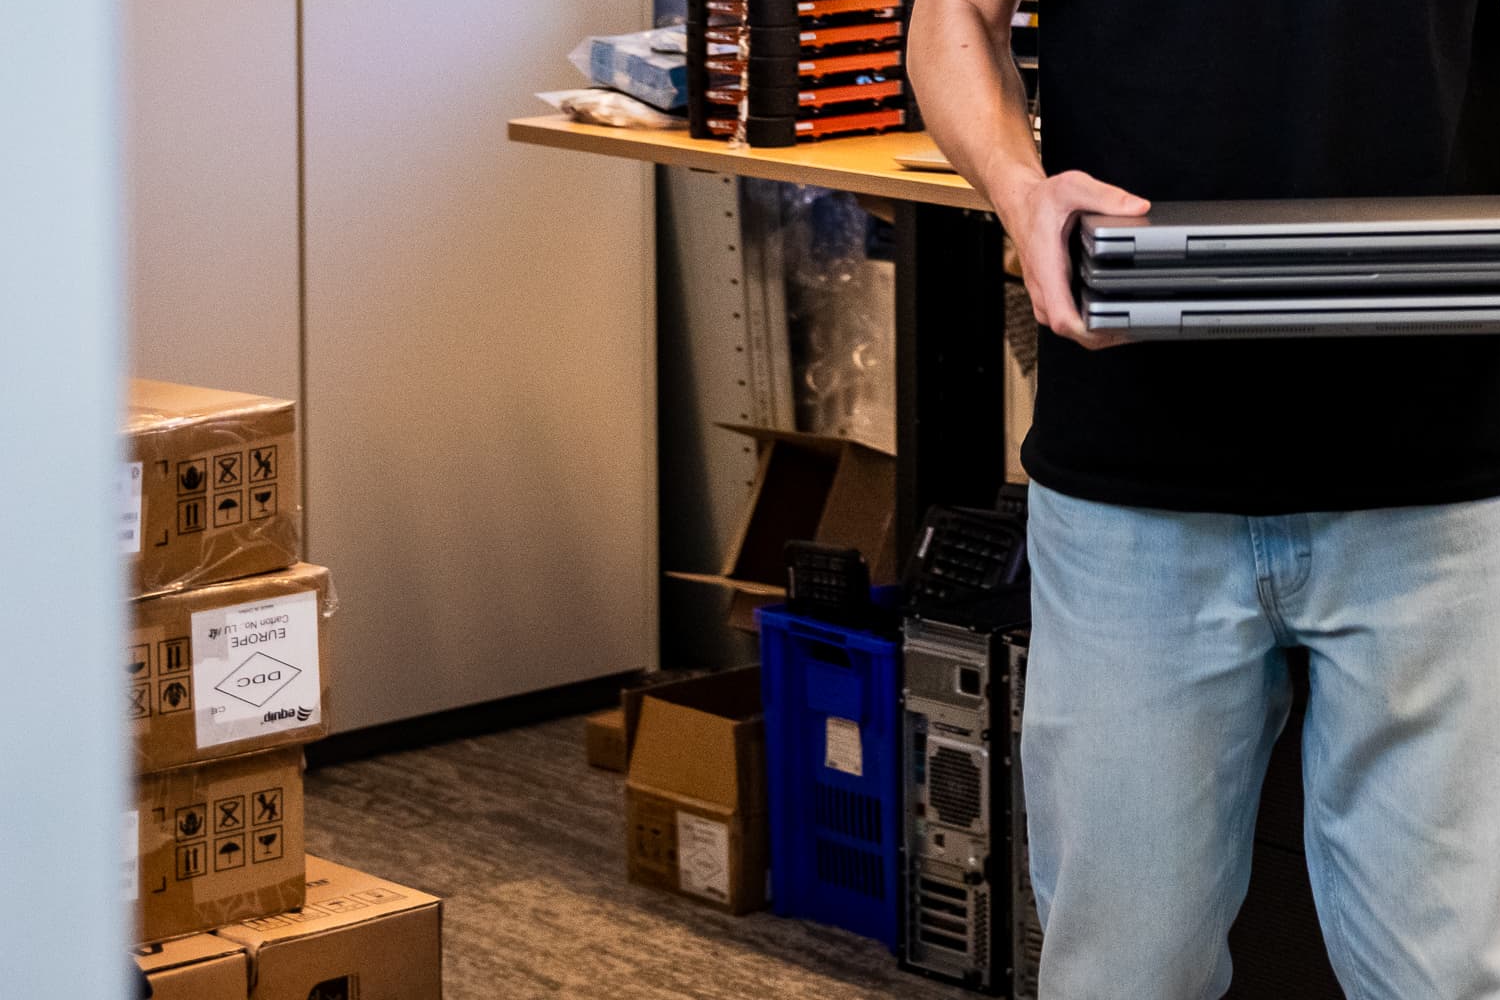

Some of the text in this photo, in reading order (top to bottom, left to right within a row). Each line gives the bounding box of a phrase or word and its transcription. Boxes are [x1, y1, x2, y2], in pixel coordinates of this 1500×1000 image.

[260, 614, 289, 626] Carton
[231, 627, 286, 648] EUROPE
[236, 670, 281, 688] DDC
[263, 708, 296, 723] equip
